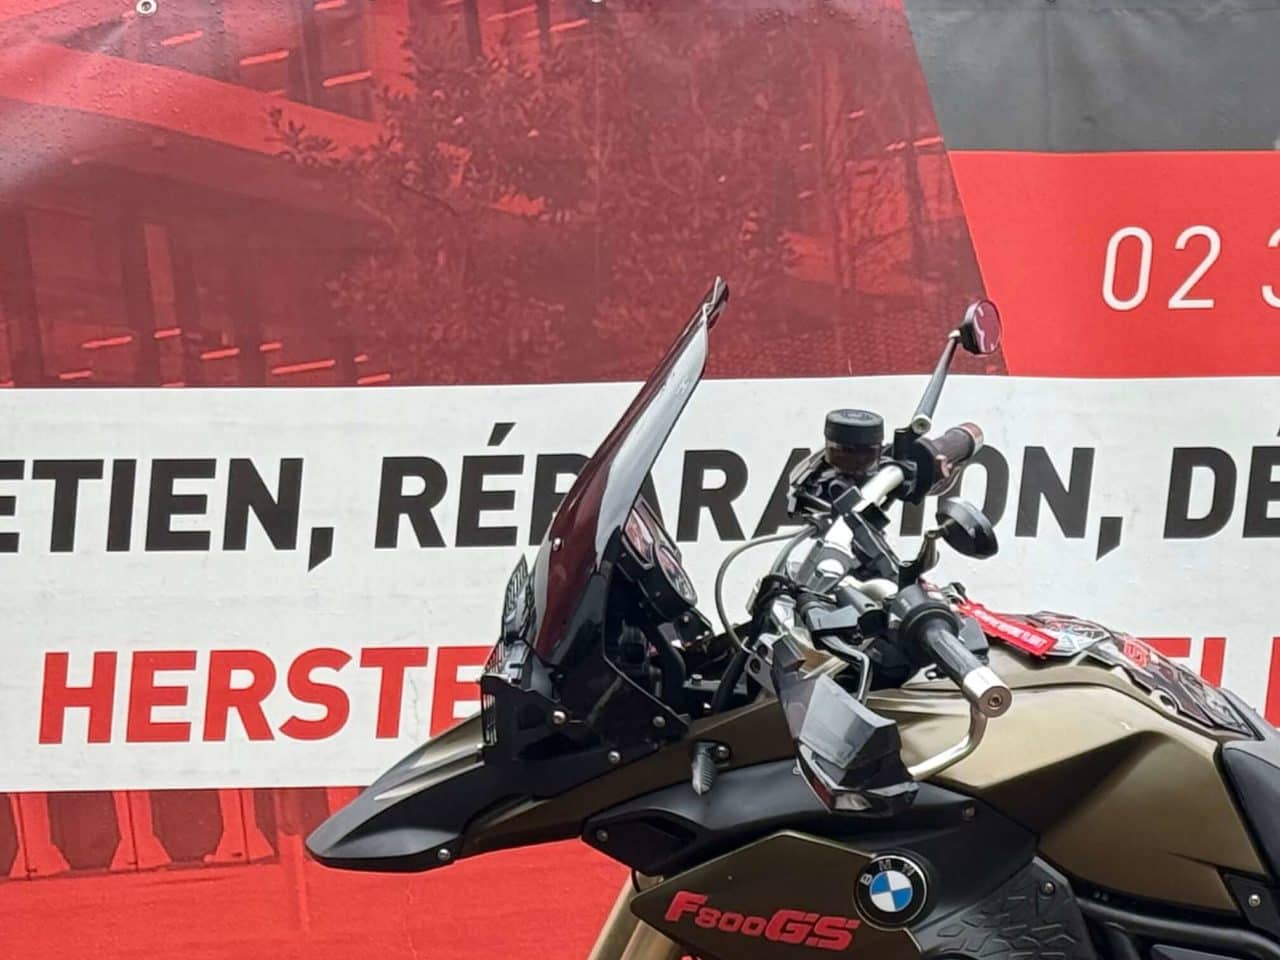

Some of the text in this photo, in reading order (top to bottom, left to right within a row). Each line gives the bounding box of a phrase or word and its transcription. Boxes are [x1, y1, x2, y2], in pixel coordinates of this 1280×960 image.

[1102, 225, 1221, 310] 02
[38, 646, 493, 744] HERSTE
[860, 858, 917, 886] BMW
[665, 890, 860, 950] F800GS
